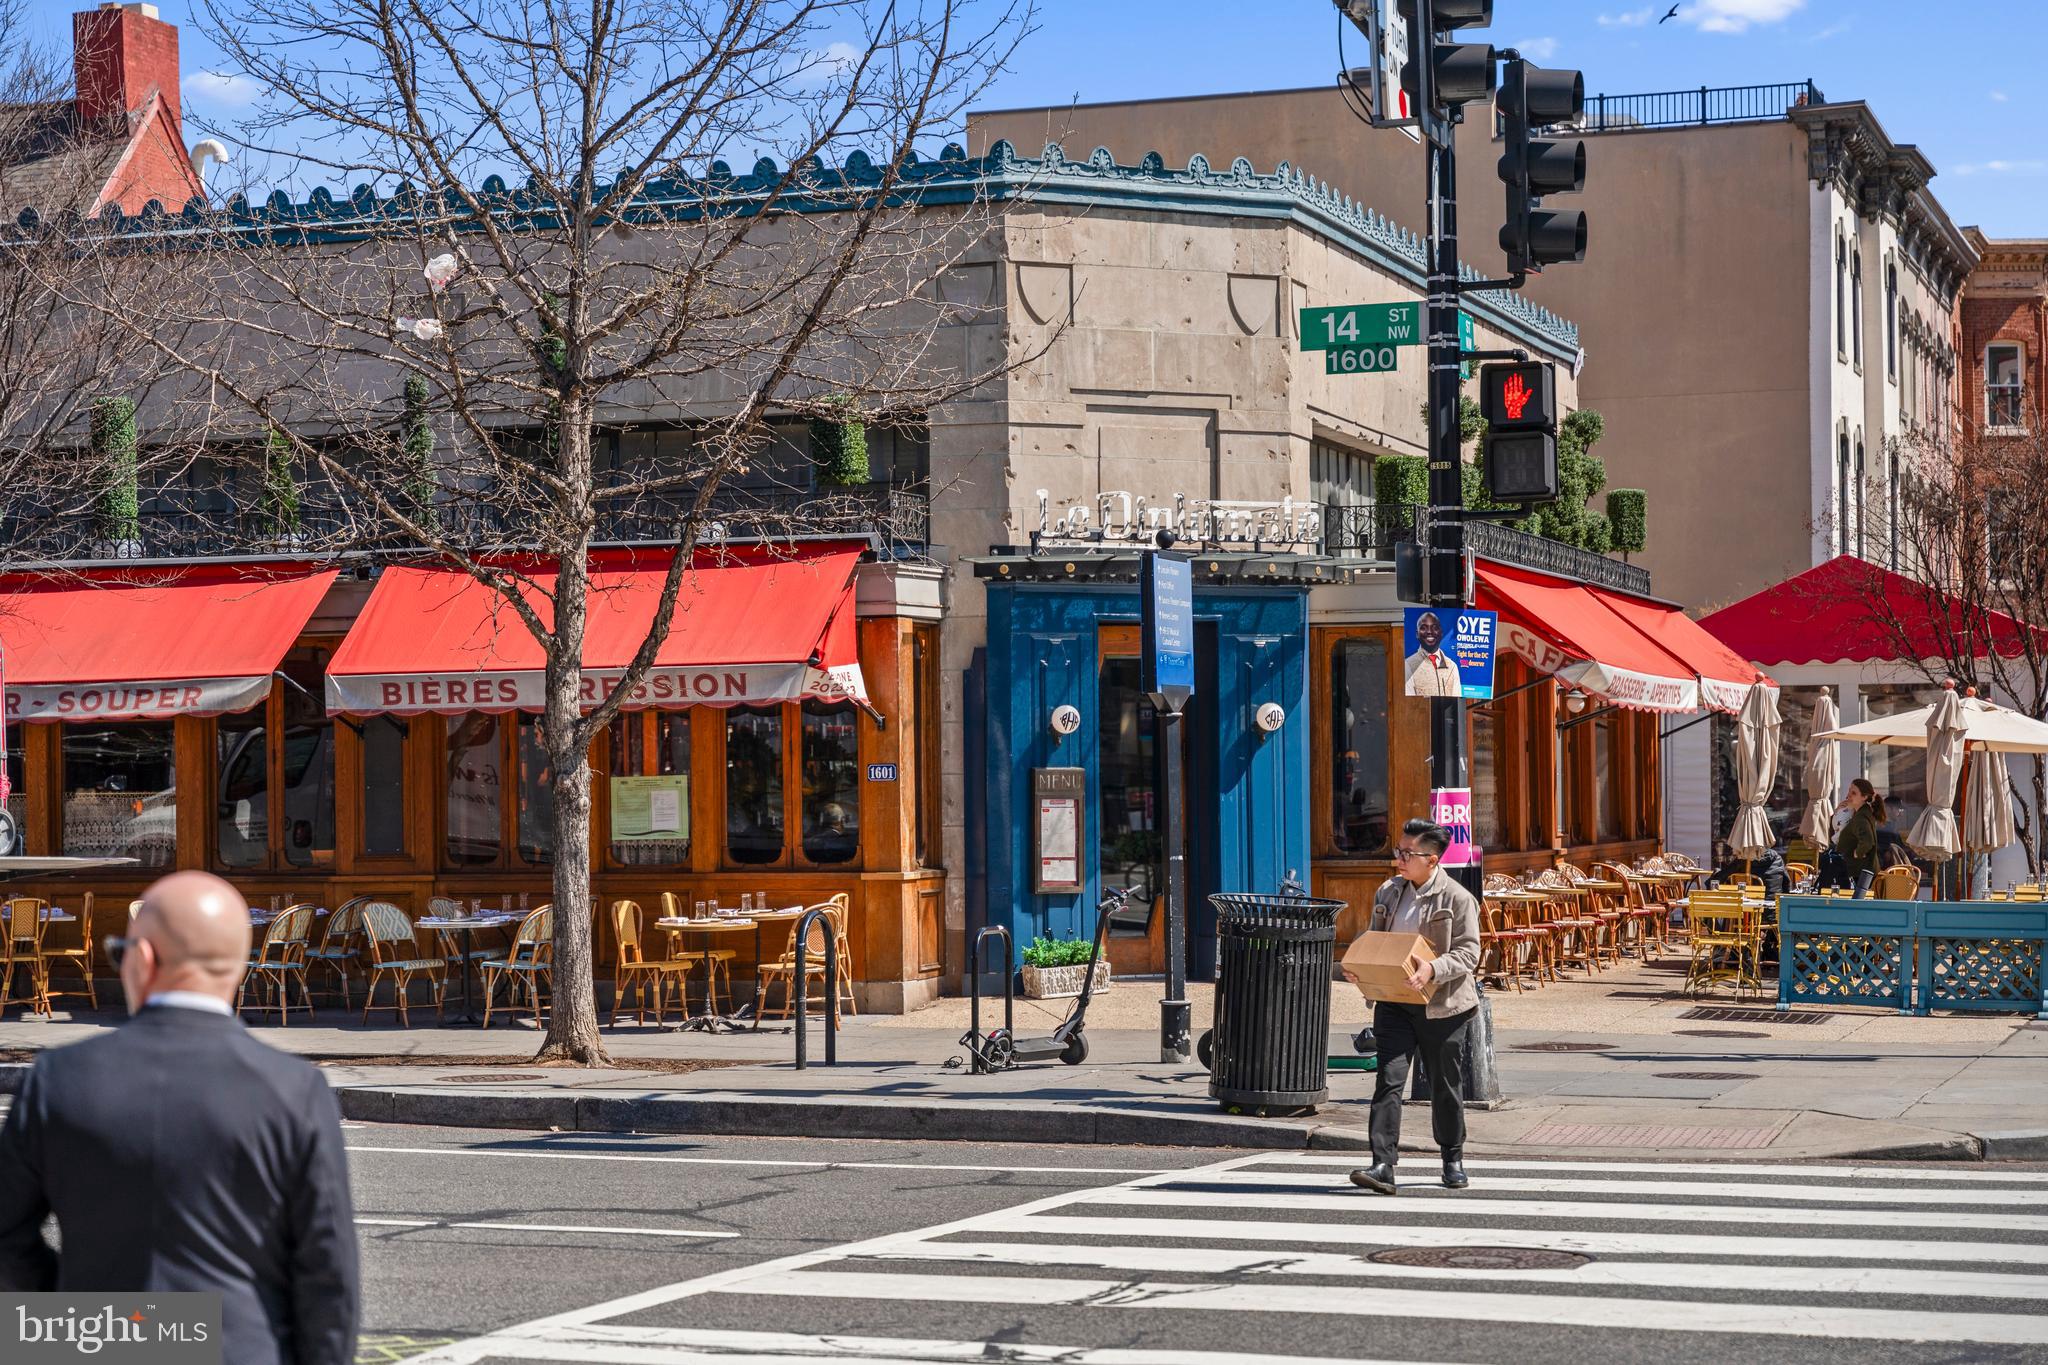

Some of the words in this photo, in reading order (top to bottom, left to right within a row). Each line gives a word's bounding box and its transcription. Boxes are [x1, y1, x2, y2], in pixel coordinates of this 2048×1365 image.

[1391, 22, 1408, 56] TURN
[1389, 51, 1399, 78] ON
[1321, 311, 1360, 343] 14
[1389, 308, 1410, 322] ST
[1388, 325, 1411, 339] NW
[1328, 347, 1395, 372] 1600
[1035, 489, 1092, 538] Le
[1457, 616, 1490, 634] OYE
[1456, 634, 1490, 643] OWOLEWA
[57, 686, 203, 713] SOUPER
[381, 676, 519, 706] BIÈRES
[579, 672, 748, 700] RESSION
[870, 766, 894, 779] 1601
[1039, 774, 1082, 789] MENU
